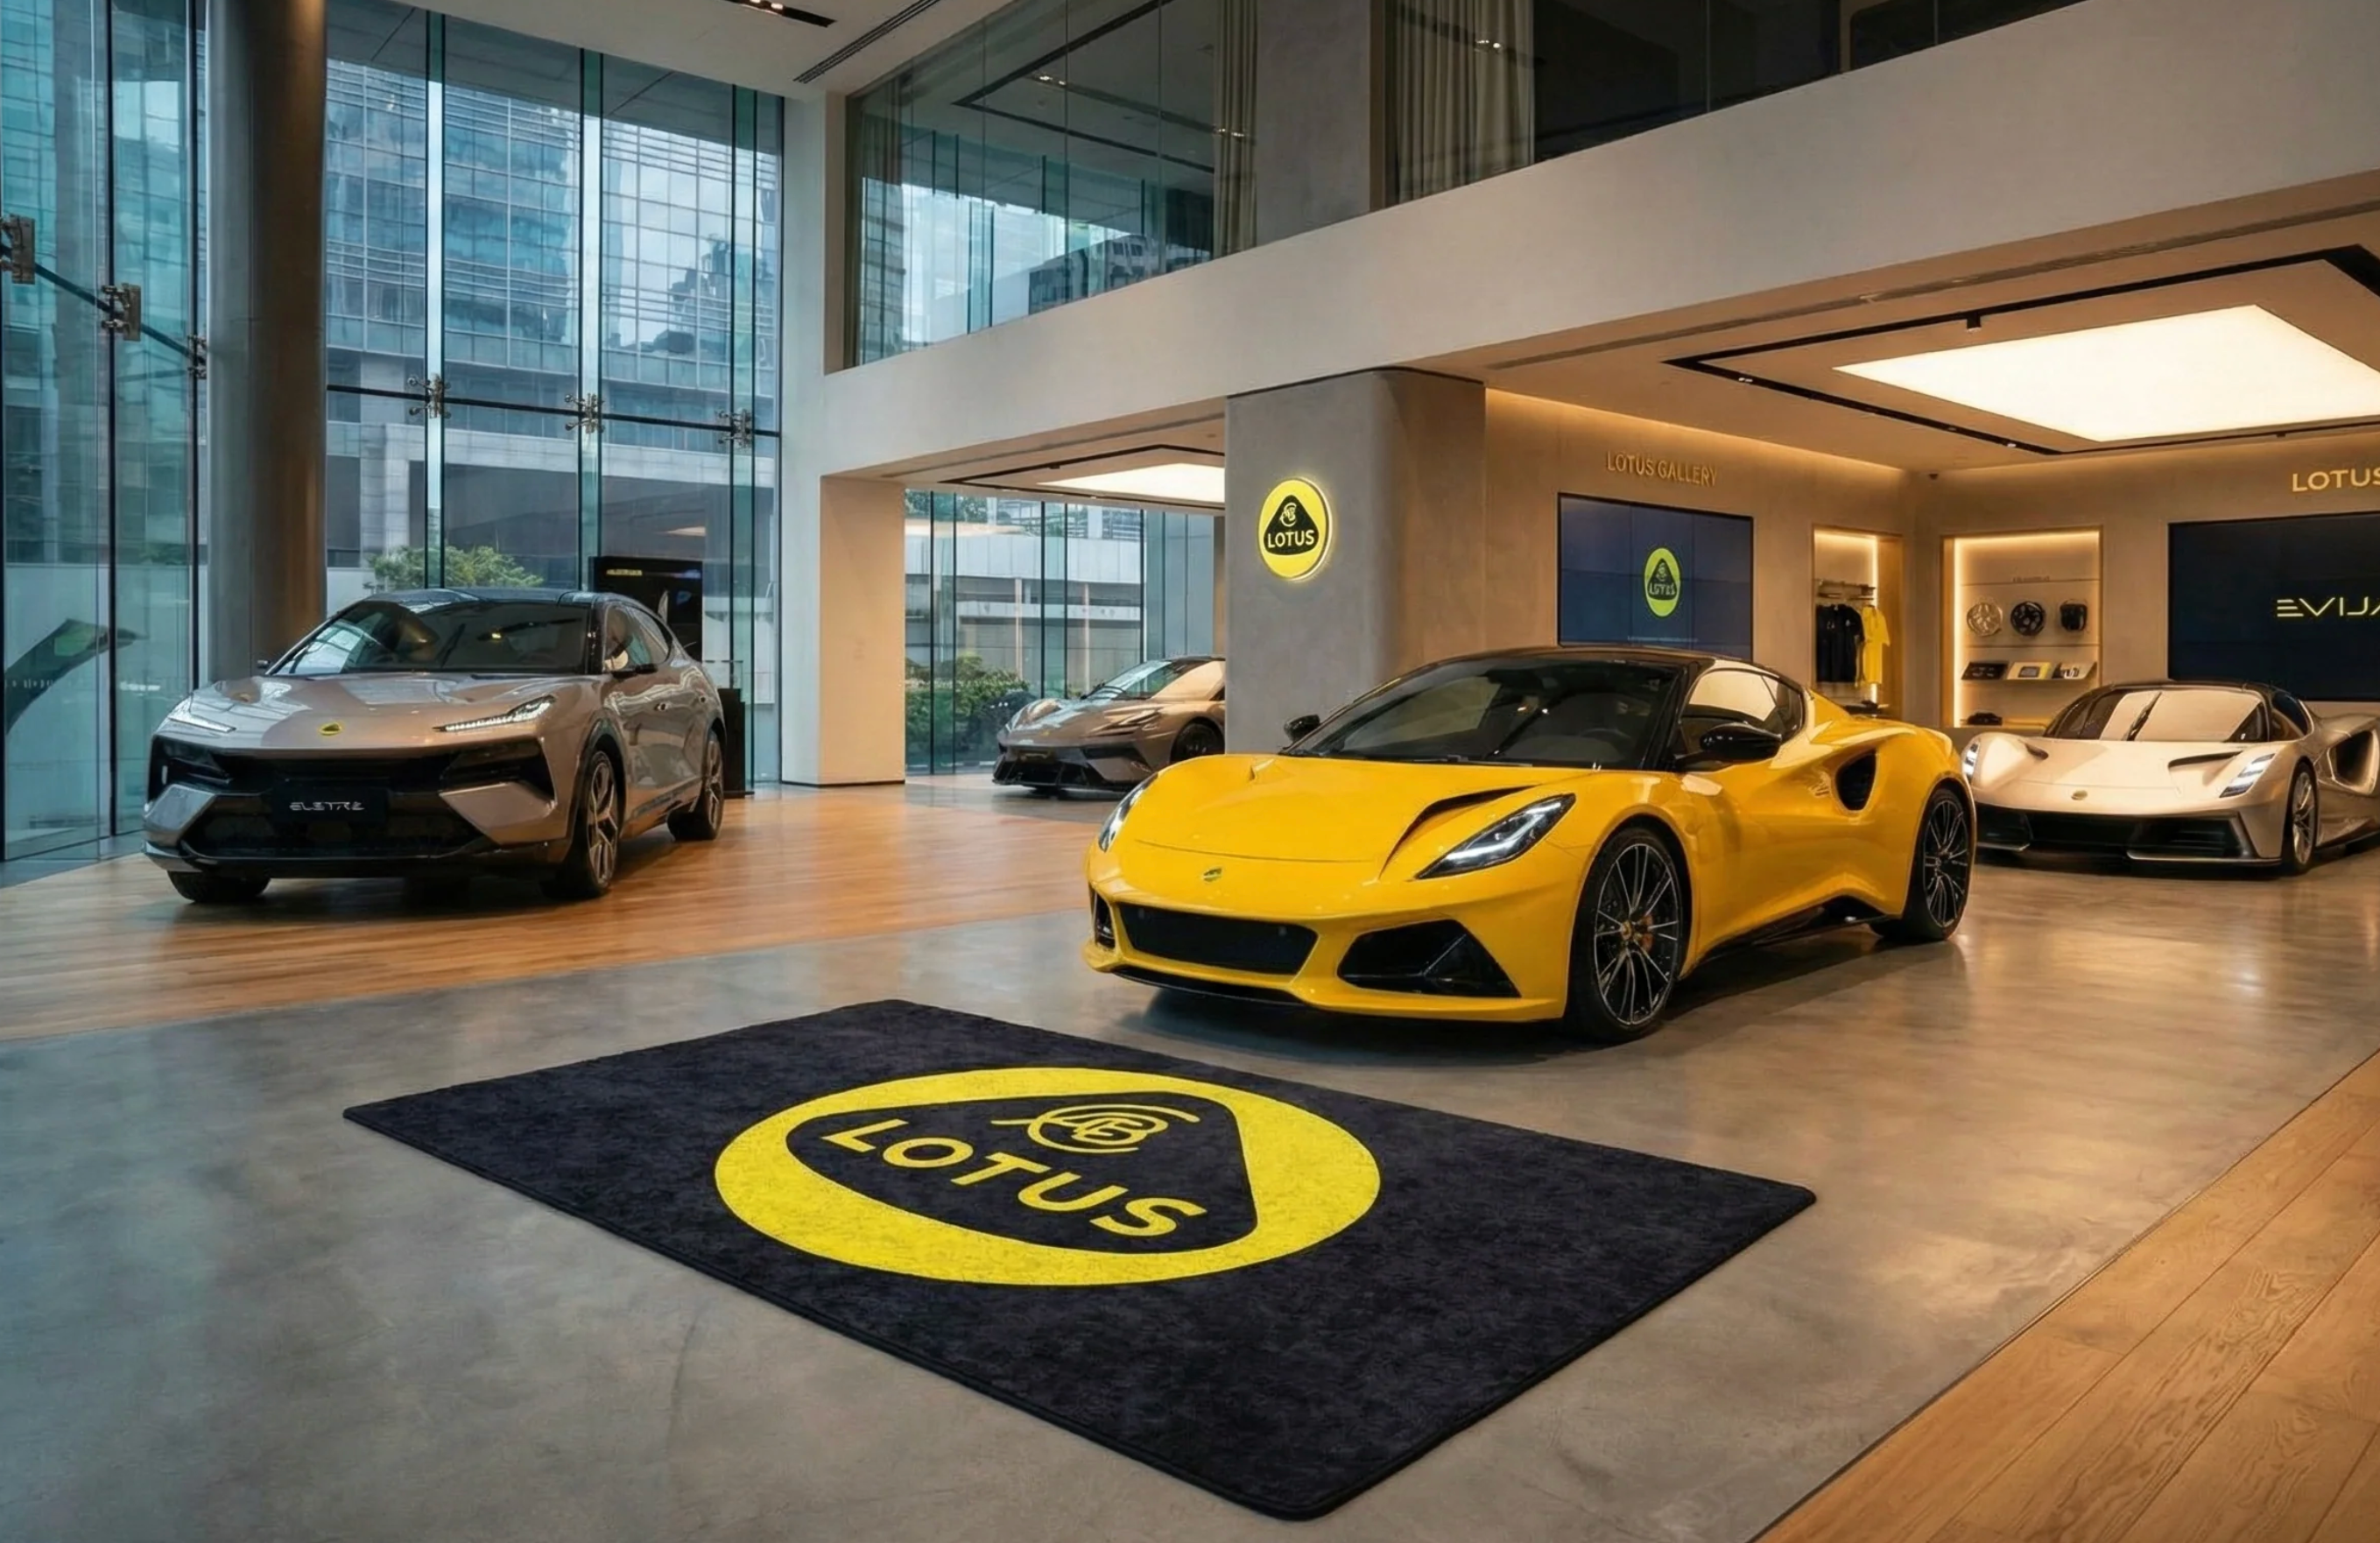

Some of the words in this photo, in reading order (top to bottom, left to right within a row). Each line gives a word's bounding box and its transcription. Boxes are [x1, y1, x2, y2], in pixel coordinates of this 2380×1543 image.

[1607, 451, 1654, 476] LOTUS
[1658, 460, 1715, 487] GALLERY
[1267, 529, 1315, 548] LOTUS
[821, 1118, 1207, 1237] LOTUS
